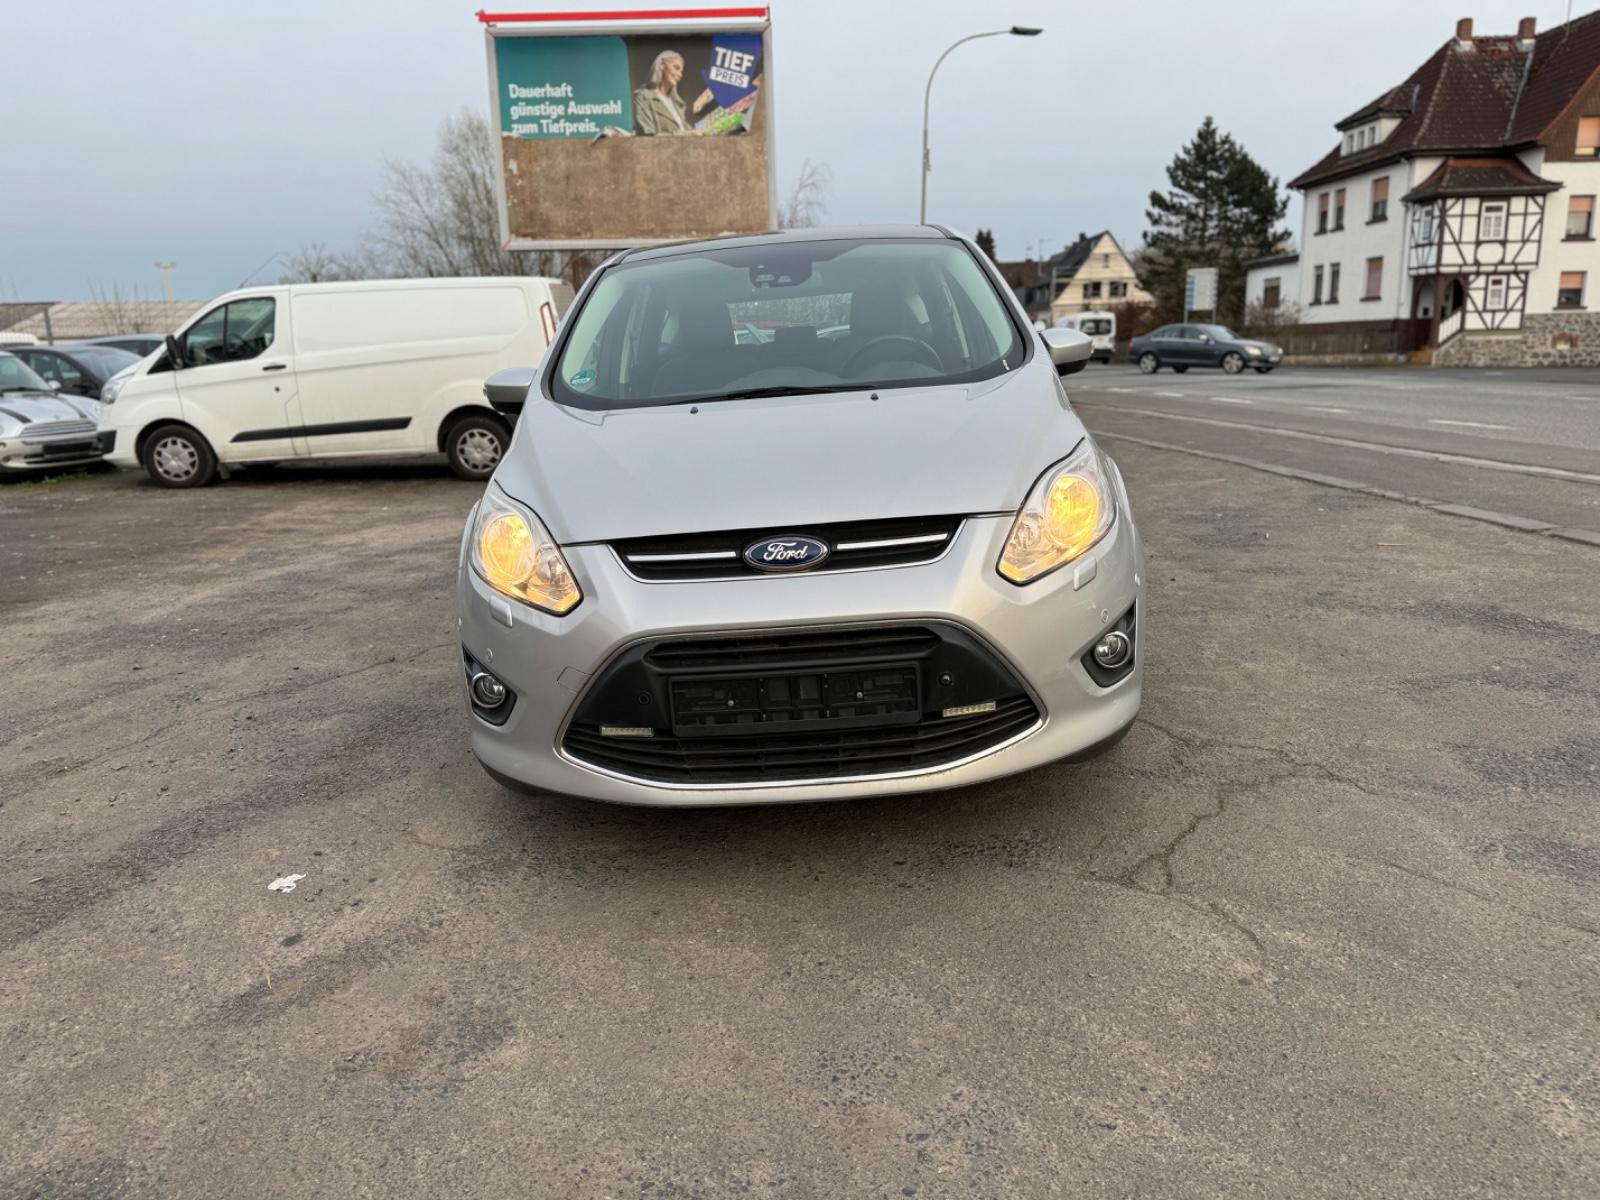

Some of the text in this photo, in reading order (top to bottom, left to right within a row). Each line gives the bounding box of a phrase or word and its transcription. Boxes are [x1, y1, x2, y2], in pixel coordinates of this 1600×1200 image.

[715, 46, 754, 73] TIEF
[715, 68, 745, 86] PREIS
[508, 83, 573, 98] Dauerhaft
[510, 99, 622, 120] günstige Auswahl
[511, 118, 600, 136] zum Tiefpreis.
[763, 542, 808, 561] Ford
